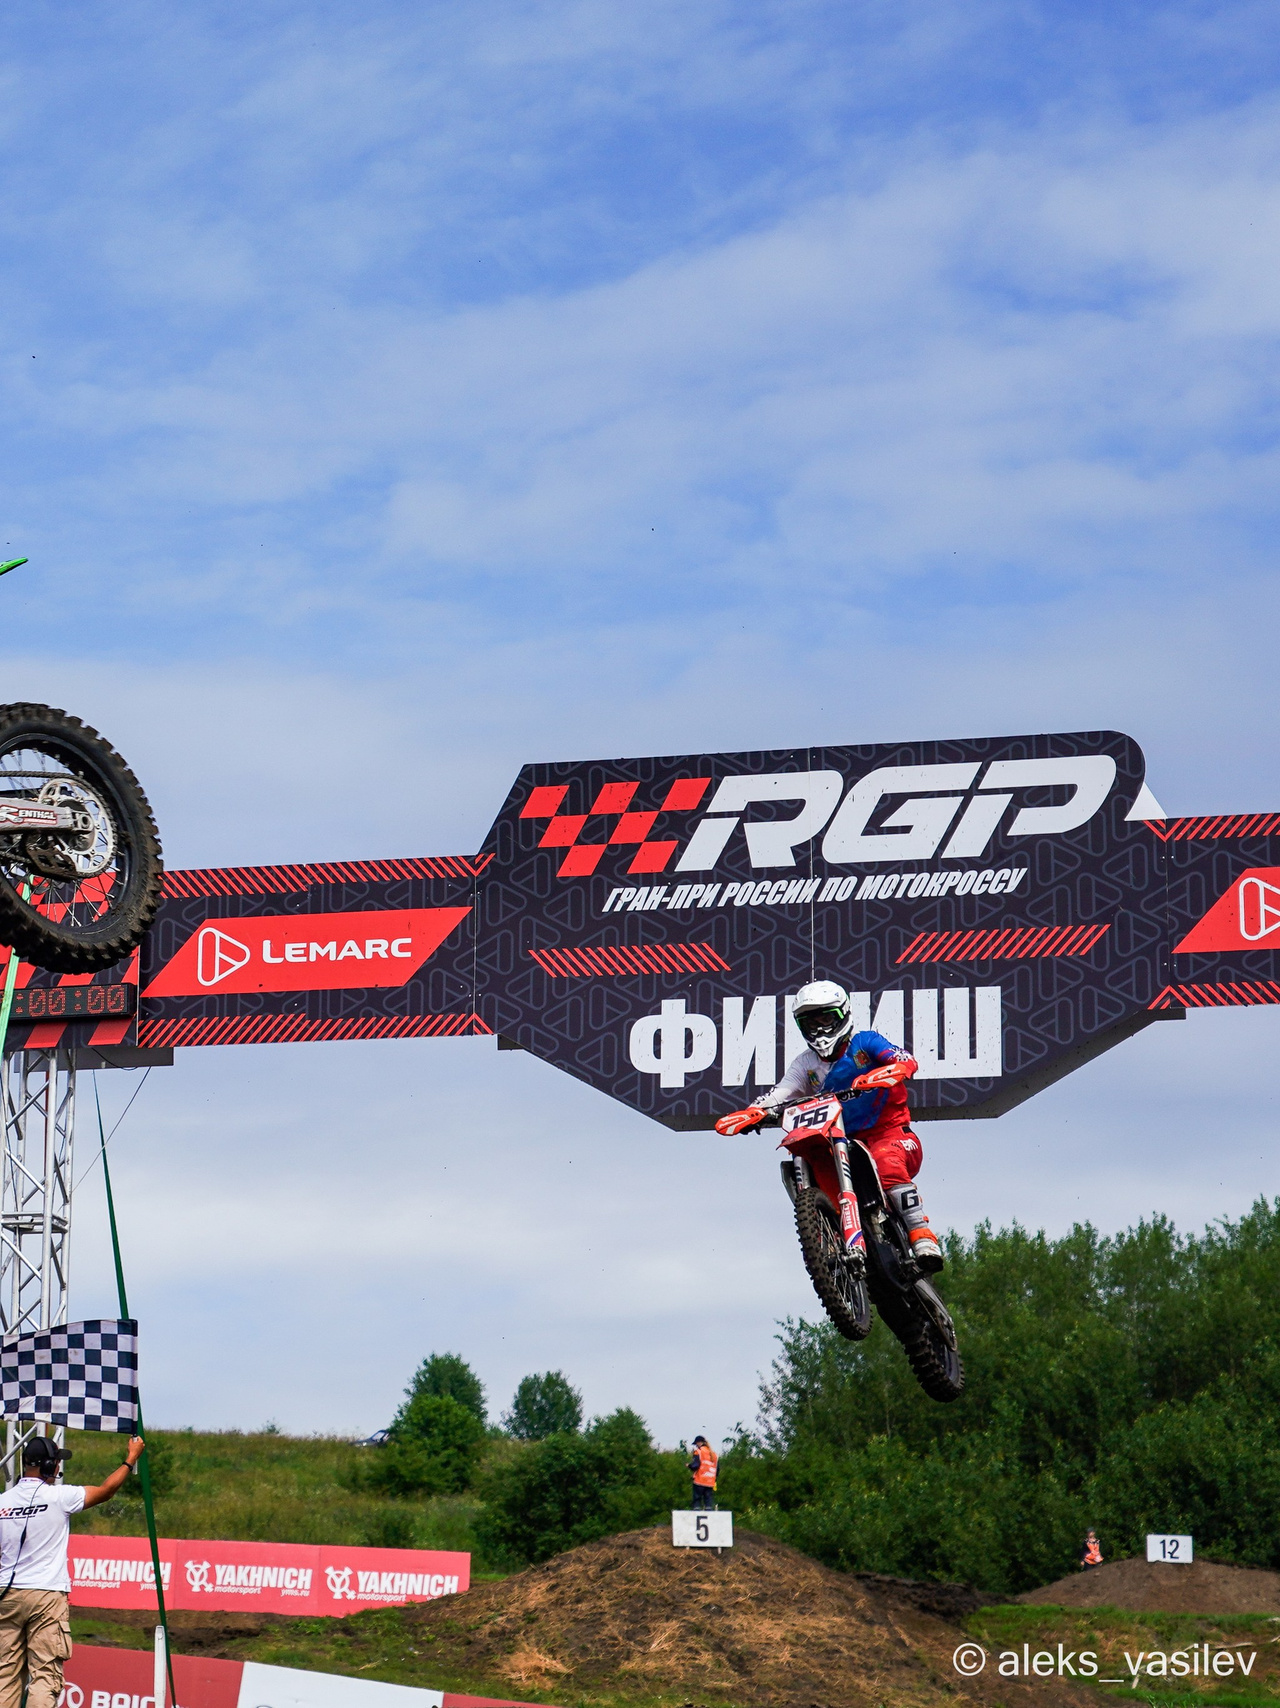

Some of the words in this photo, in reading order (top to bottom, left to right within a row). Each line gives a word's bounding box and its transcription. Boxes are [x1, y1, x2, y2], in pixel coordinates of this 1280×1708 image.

[675, 754, 1117, 872] RGP
[601, 882, 723, 913] ГРАН-ПРИ
[717, 877, 823, 907] РОССИИ
[816, 875, 858, 902] ПО
[854, 867, 1028, 900] МОТОКРОССУ
[262, 937, 412, 964] LEMARC
[792, 1105, 829, 1131] 156
[9, 1504, 49, 1517] RGP
[695, 1515, 710, 1542] 5
[1159, 1538, 1180, 1561] 12
[72, 1558, 172, 1584] YAKHNICH
[215, 1564, 313, 1589] YAKHNICH
[357, 1570, 459, 1597] YAKHNICH
